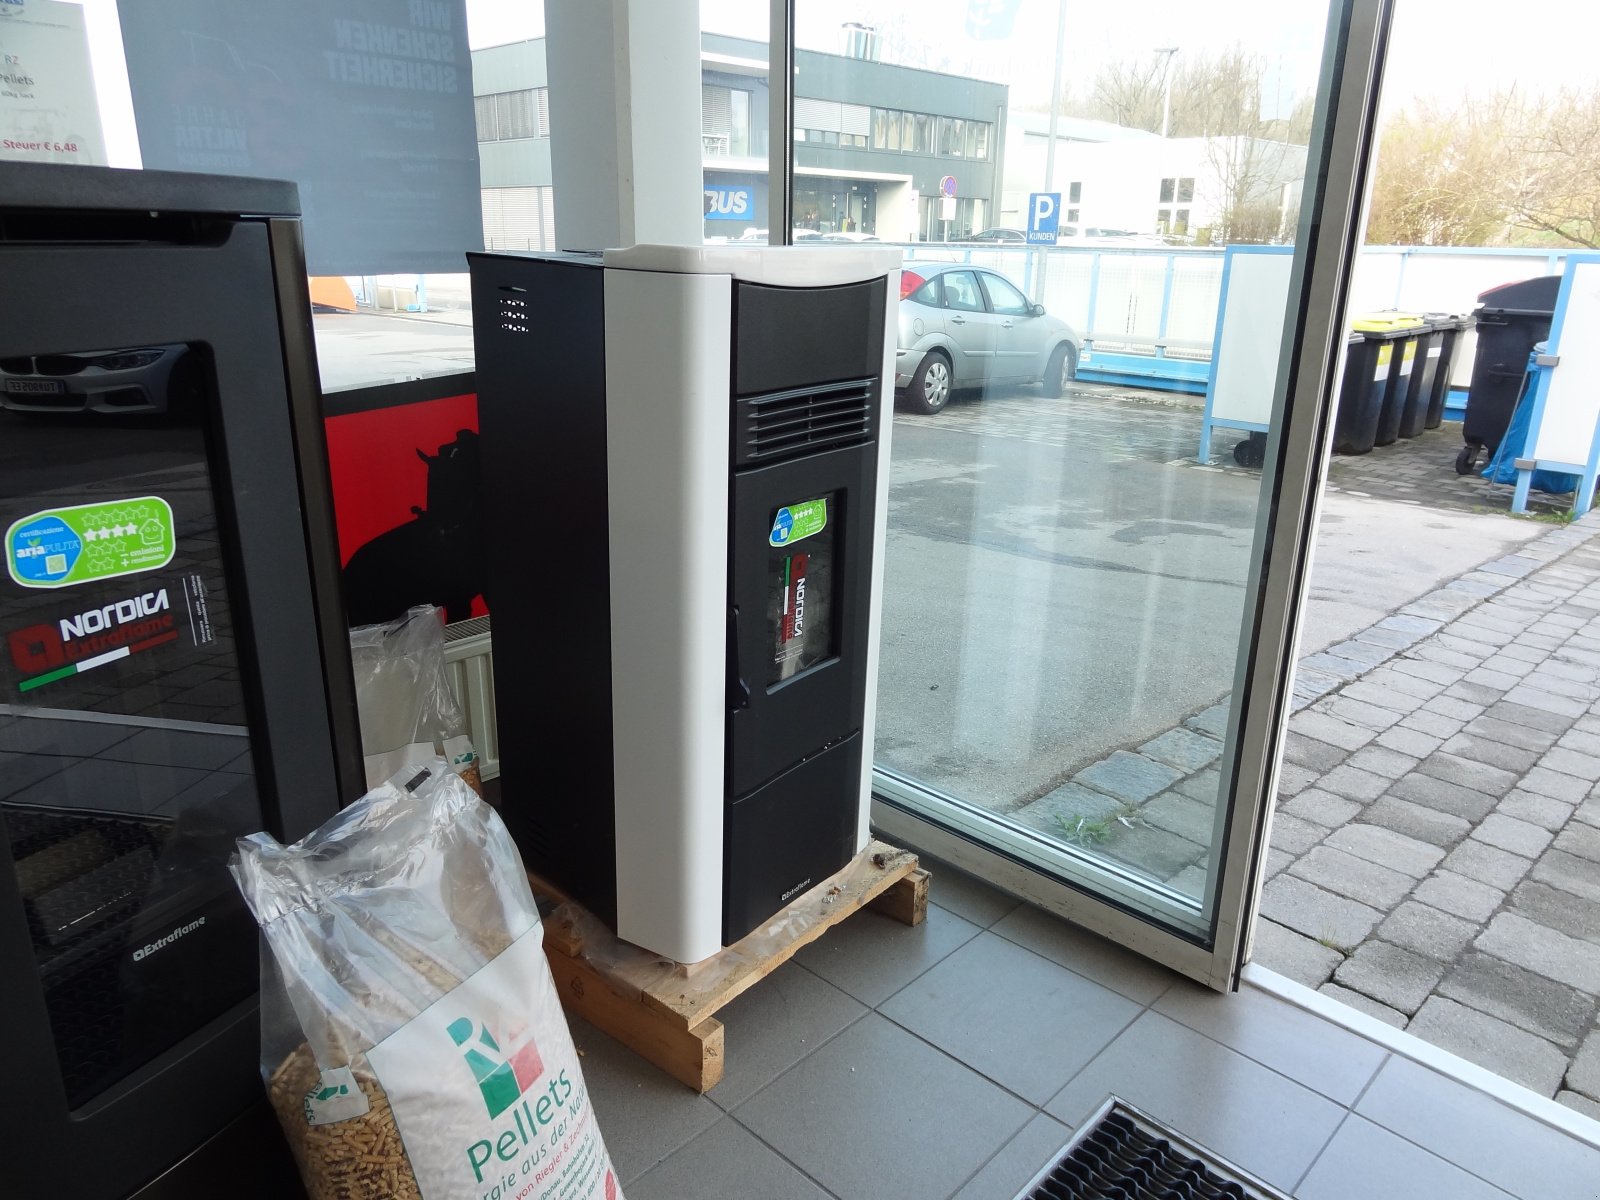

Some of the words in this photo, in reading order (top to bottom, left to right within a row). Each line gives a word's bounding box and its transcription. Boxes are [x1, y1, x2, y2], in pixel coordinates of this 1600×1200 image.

[3, 139, 42, 151] Steuer
[54, 142, 79, 153] 6,48
[1033, 195, 1055, 231] P
[1029, 231, 1056, 241] KUNDEN
[143, 916, 206, 956] Extraflame
[466, 1068, 572, 1185] Pellets
[521, 1143, 547, 1176] aus
[550, 1116, 568, 1147] der
[535, 1150, 563, 1185] Riegler
